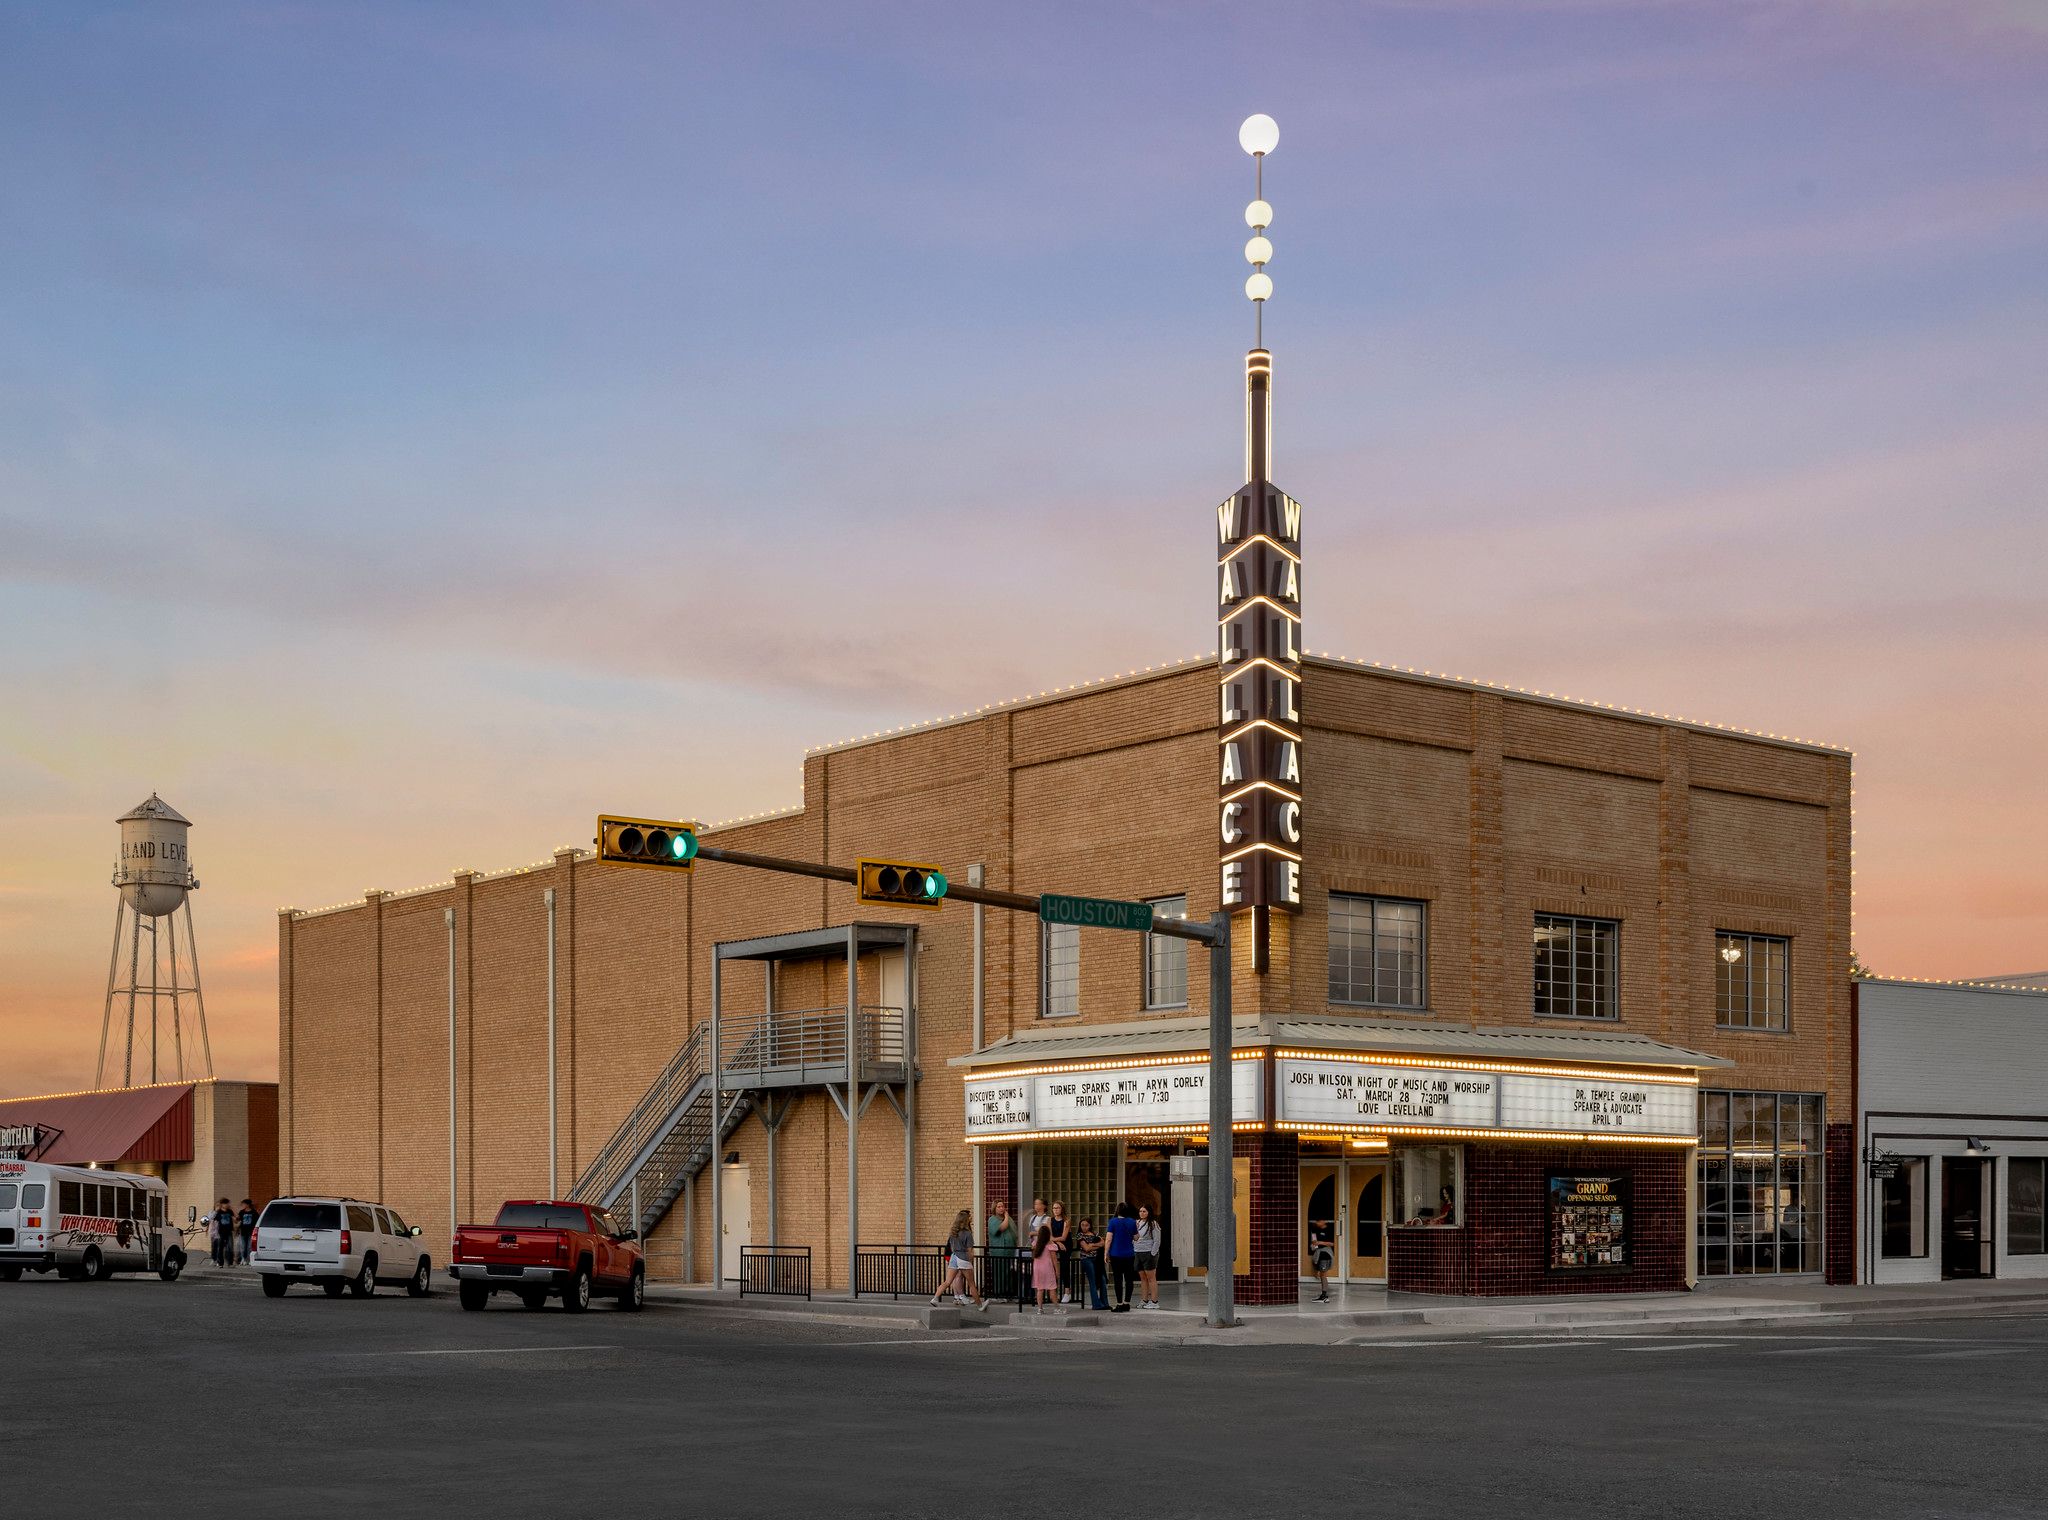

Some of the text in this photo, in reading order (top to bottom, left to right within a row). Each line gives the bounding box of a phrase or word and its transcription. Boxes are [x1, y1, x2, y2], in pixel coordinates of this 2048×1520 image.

[1217, 494, 1242, 905] WALLACE
[1278, 494, 1301, 905] WALLACE
[1046, 899, 1128, 925] HOUSTON
[1049, 1076, 1204, 1096] TURNER SPARKS WITH ARYN CORLEY
[1290, 1072, 1490, 1094] JOSH WILSON NIGHT OF MUSIC AND WORSHIP
[969, 1087, 1024, 1102] DISCOVER SHOWS &
[1075, 1091, 1170, 1107] FRIDAY APRIL 17 7:30
[1336, 1088, 1449, 1105] SAT. MARCH 28 7:30PM
[1575, 1089, 1647, 1102] DR. TEMPLE GRANDIN
[982, 1101, 998, 1112] TIMES
[1357, 1102, 1434, 1117] LOVE LEVELLAND
[1573, 1101, 1643, 1114] SPEAKER & ADVOCATE
[967, 1111, 1031, 1126] WALLACETHEATER.COM
[1592, 1114, 1623, 1126] APRIL 10
[0, 1127, 35, 1147] BOTHAM
[1577, 1183, 1608, 1194] GRAND
[60, 1215, 119, 1235] WHITHARRAL
